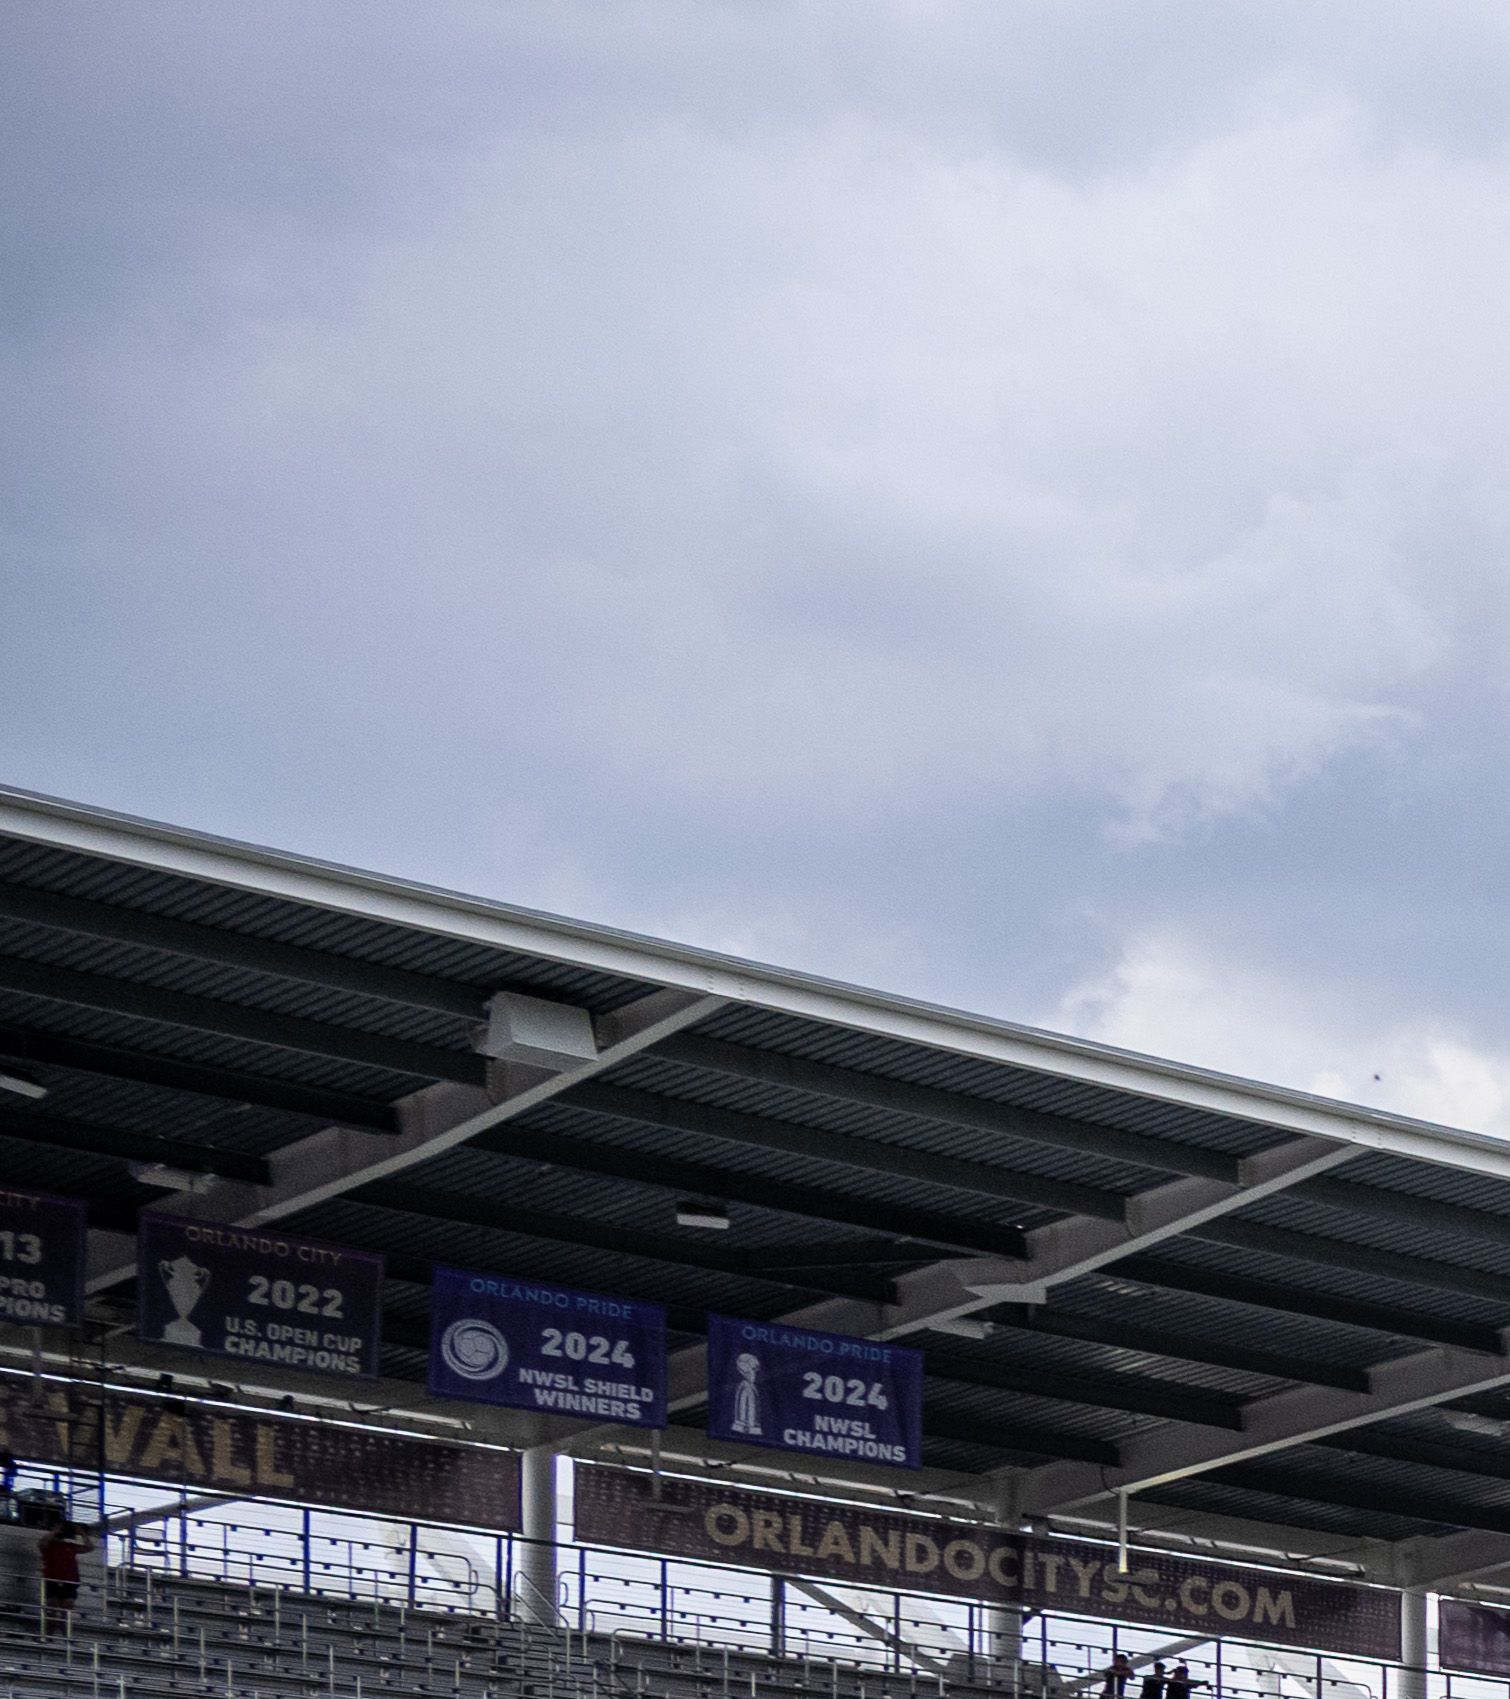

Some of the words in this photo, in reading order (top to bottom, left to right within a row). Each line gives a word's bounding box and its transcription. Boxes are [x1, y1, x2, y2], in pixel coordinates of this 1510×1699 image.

[185, 1226, 289, 1257] ORLANDO
[297, 1246, 342, 1266] CITY
[248, 1275, 345, 1319] 2022
[470, 1278, 569, 1308] ORLANDO
[577, 1296, 633, 1320] PRIDE
[225, 1316, 262, 1337] U.S.
[266, 1323, 319, 1347] OPEN
[323, 1331, 363, 1353] CUP
[541, 1327, 636, 1369] 2024
[742, 1325, 834, 1356] ORLANDO
[838, 1343, 892, 1364] PRIDE
[224, 1335, 362, 1374] CHAMPIONS
[518, 1368, 581, 1391] NWSL
[584, 1379, 655, 1403] SHIELD
[534, 1387, 642, 1420] WINNERS
[802, 1371, 888, 1411] 2024
[783, 1427, 907, 1463] CHAMPIONS
[814, 1414, 877, 1440] NWSL
[704, 1502, 1296, 1630] ORLANDOCITYSC.COM
